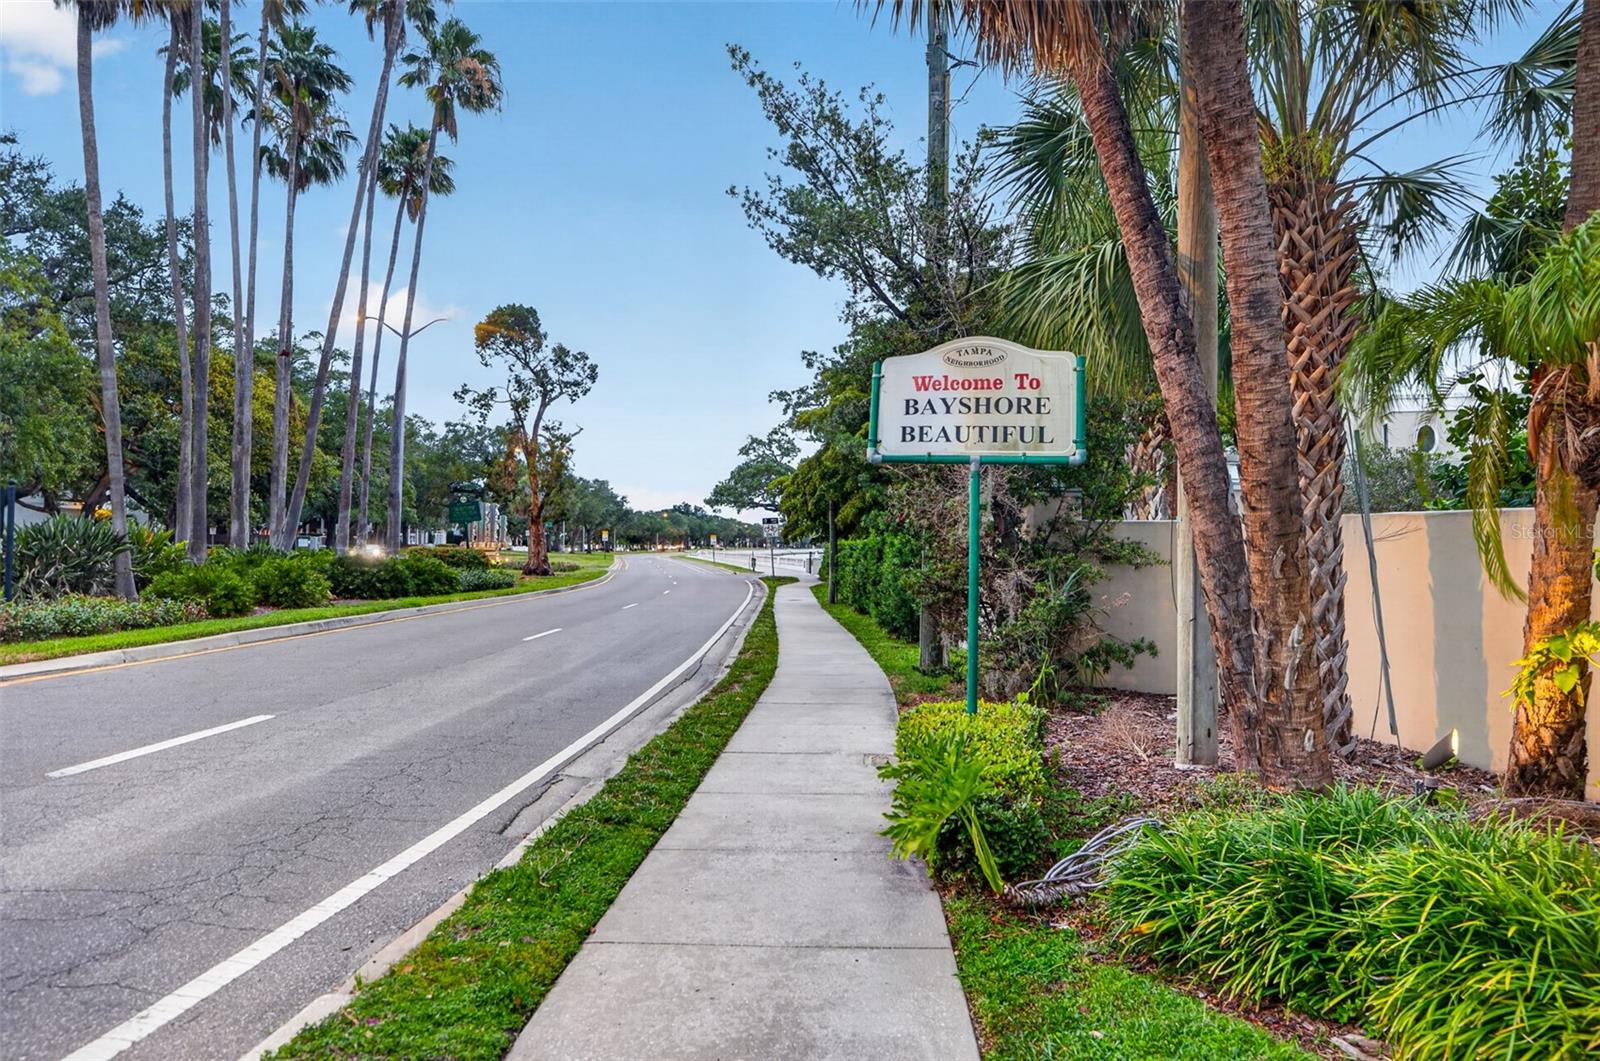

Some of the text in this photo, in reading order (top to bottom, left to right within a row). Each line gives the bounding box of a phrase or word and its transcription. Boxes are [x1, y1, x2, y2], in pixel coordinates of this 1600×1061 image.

[945, 355, 1005, 366] NEIGHBORHOOD
[956, 346, 992, 357] TAMPA
[912, 373, 1041, 392] Welcome To
[904, 397, 1051, 416] BAYSHORE
[900, 425, 1054, 444] BEAUTIFUL
